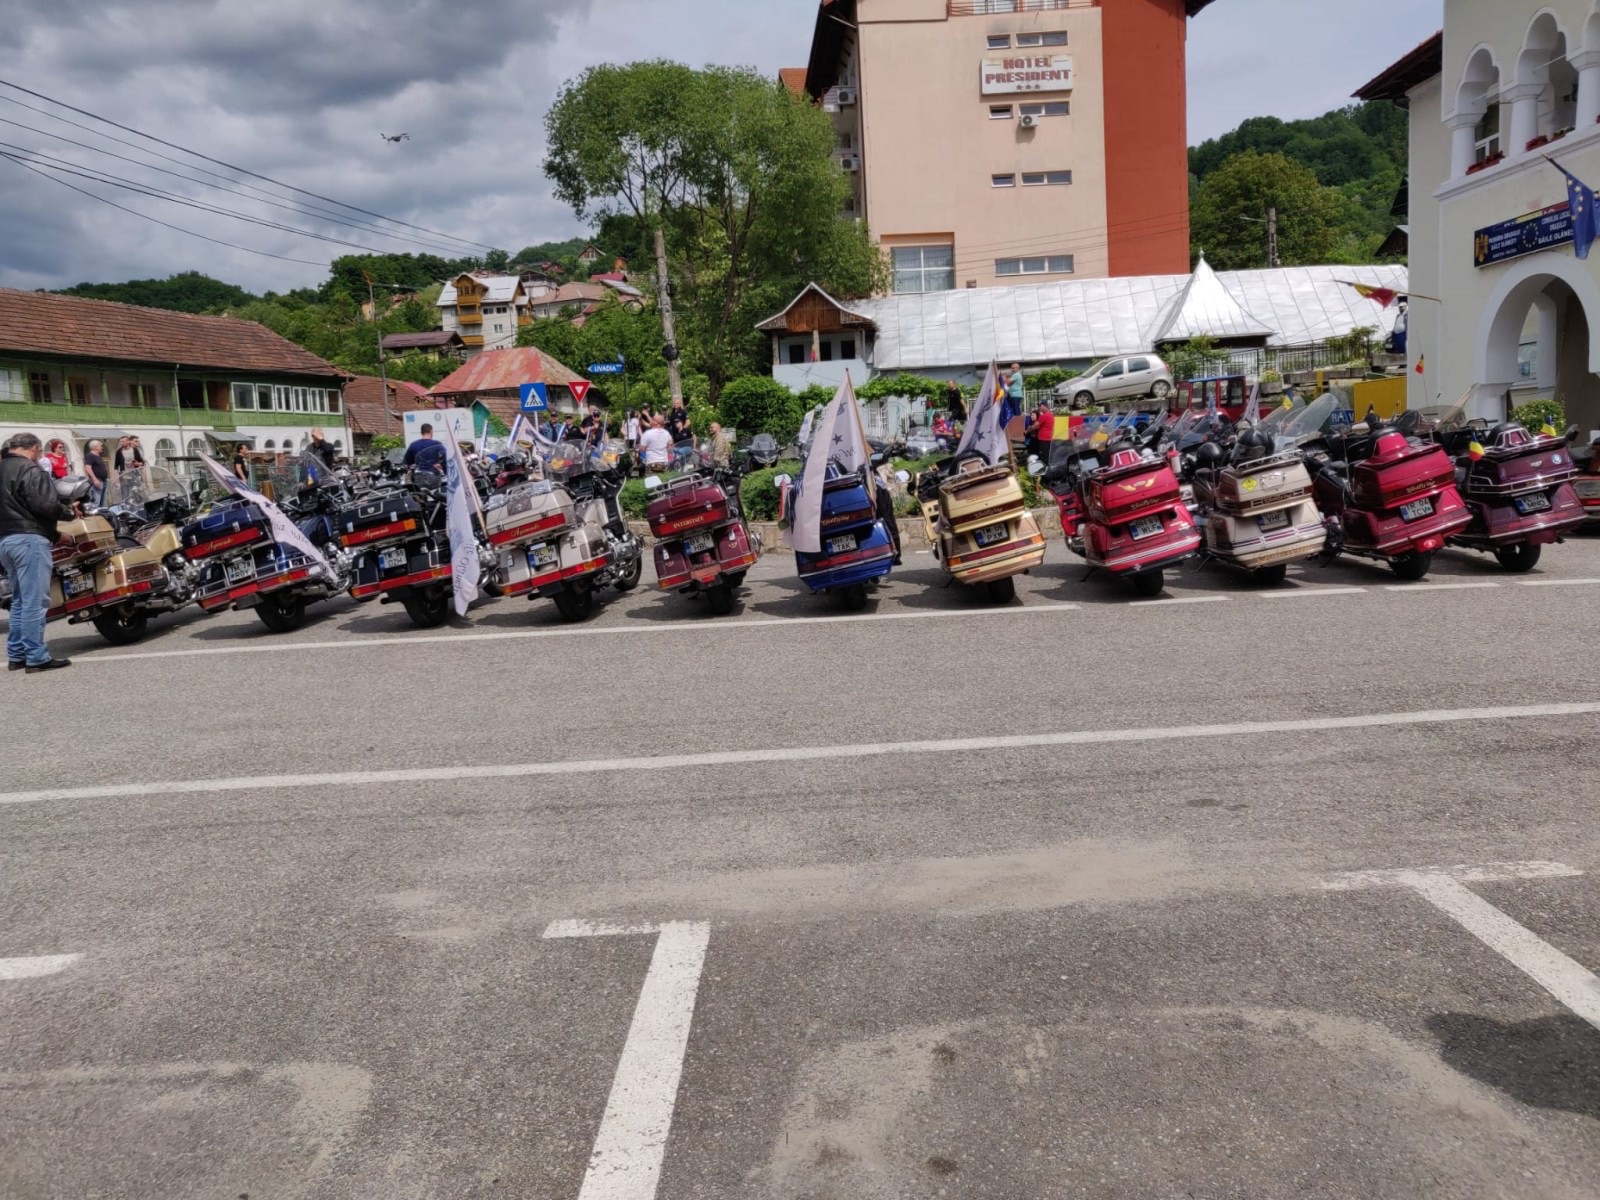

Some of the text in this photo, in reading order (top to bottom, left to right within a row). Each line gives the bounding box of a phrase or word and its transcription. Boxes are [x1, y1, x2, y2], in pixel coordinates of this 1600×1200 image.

[1003, 56, 1052, 69] HOTEL
[985, 69, 1071, 84] PRESIDENT
[673, 516, 704, 529] INTERSTATE
